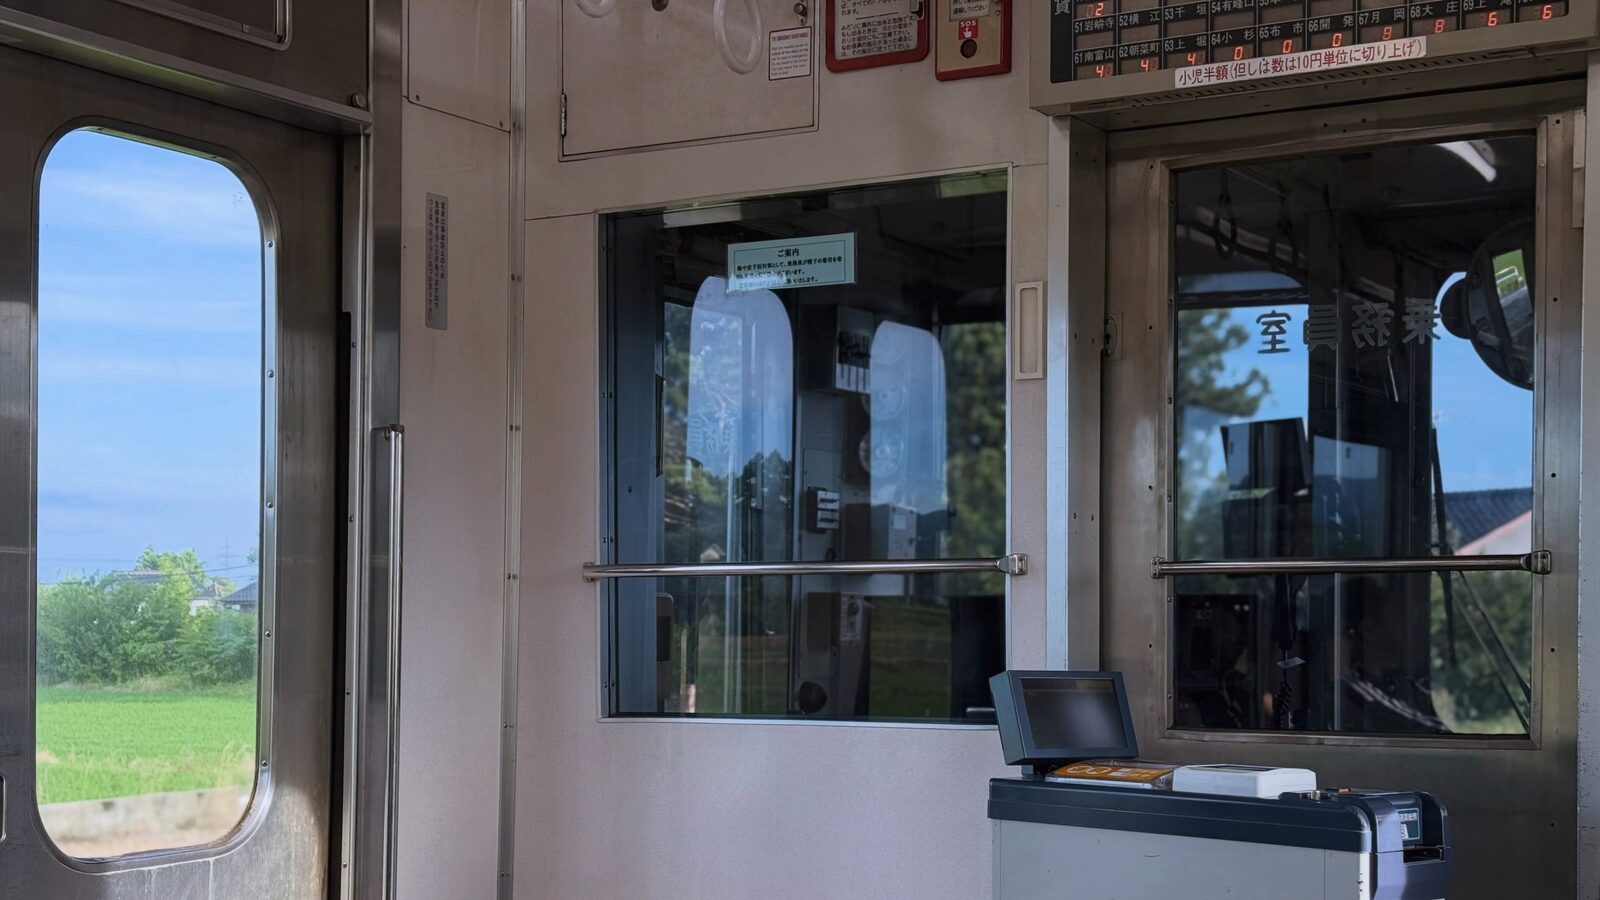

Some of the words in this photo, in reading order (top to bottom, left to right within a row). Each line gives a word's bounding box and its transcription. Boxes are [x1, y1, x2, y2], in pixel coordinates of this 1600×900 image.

[960, 19, 976, 28] SOS
[777, 248, 800, 258] ご案内
